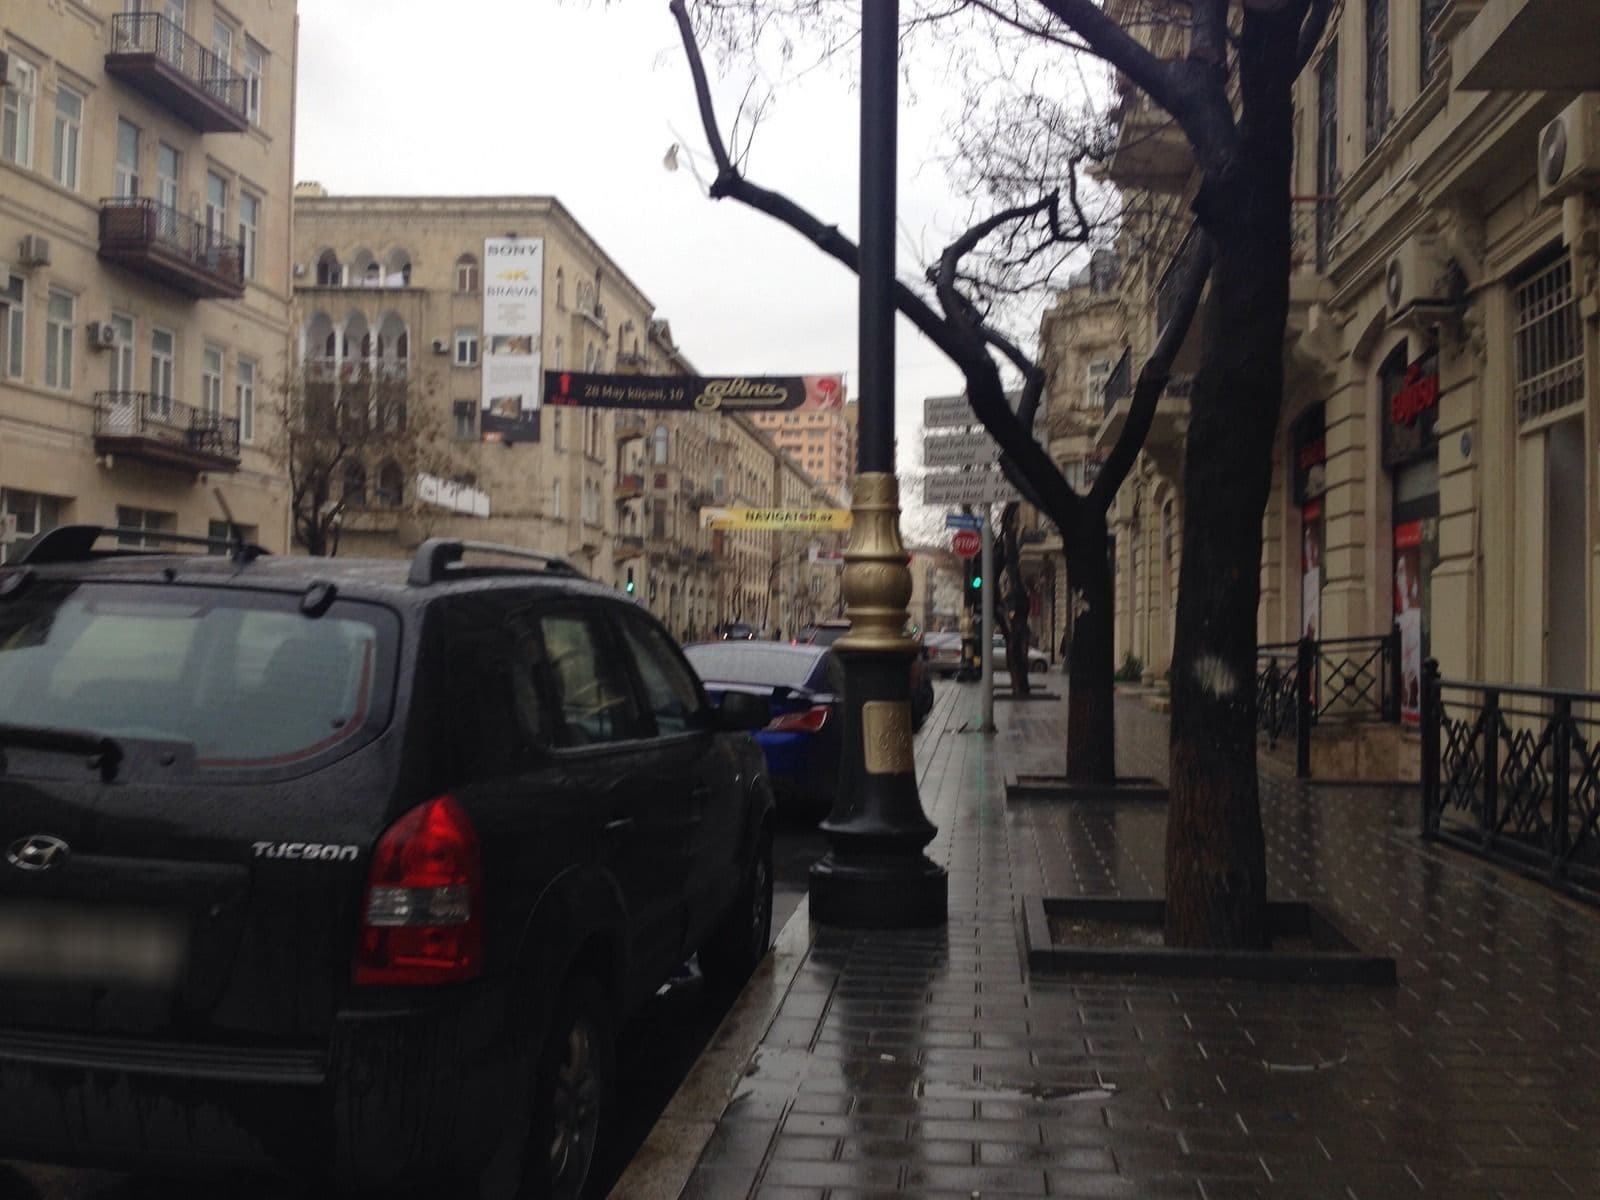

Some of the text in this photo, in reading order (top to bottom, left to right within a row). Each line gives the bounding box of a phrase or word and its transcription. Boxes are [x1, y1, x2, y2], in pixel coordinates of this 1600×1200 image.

[487, 245, 538, 257] SONY
[487, 286, 538, 297] BRAVIA
[584, 384, 600, 397] 28
[602, 385, 625, 400] May
[955, 537, 979, 549] STOP
